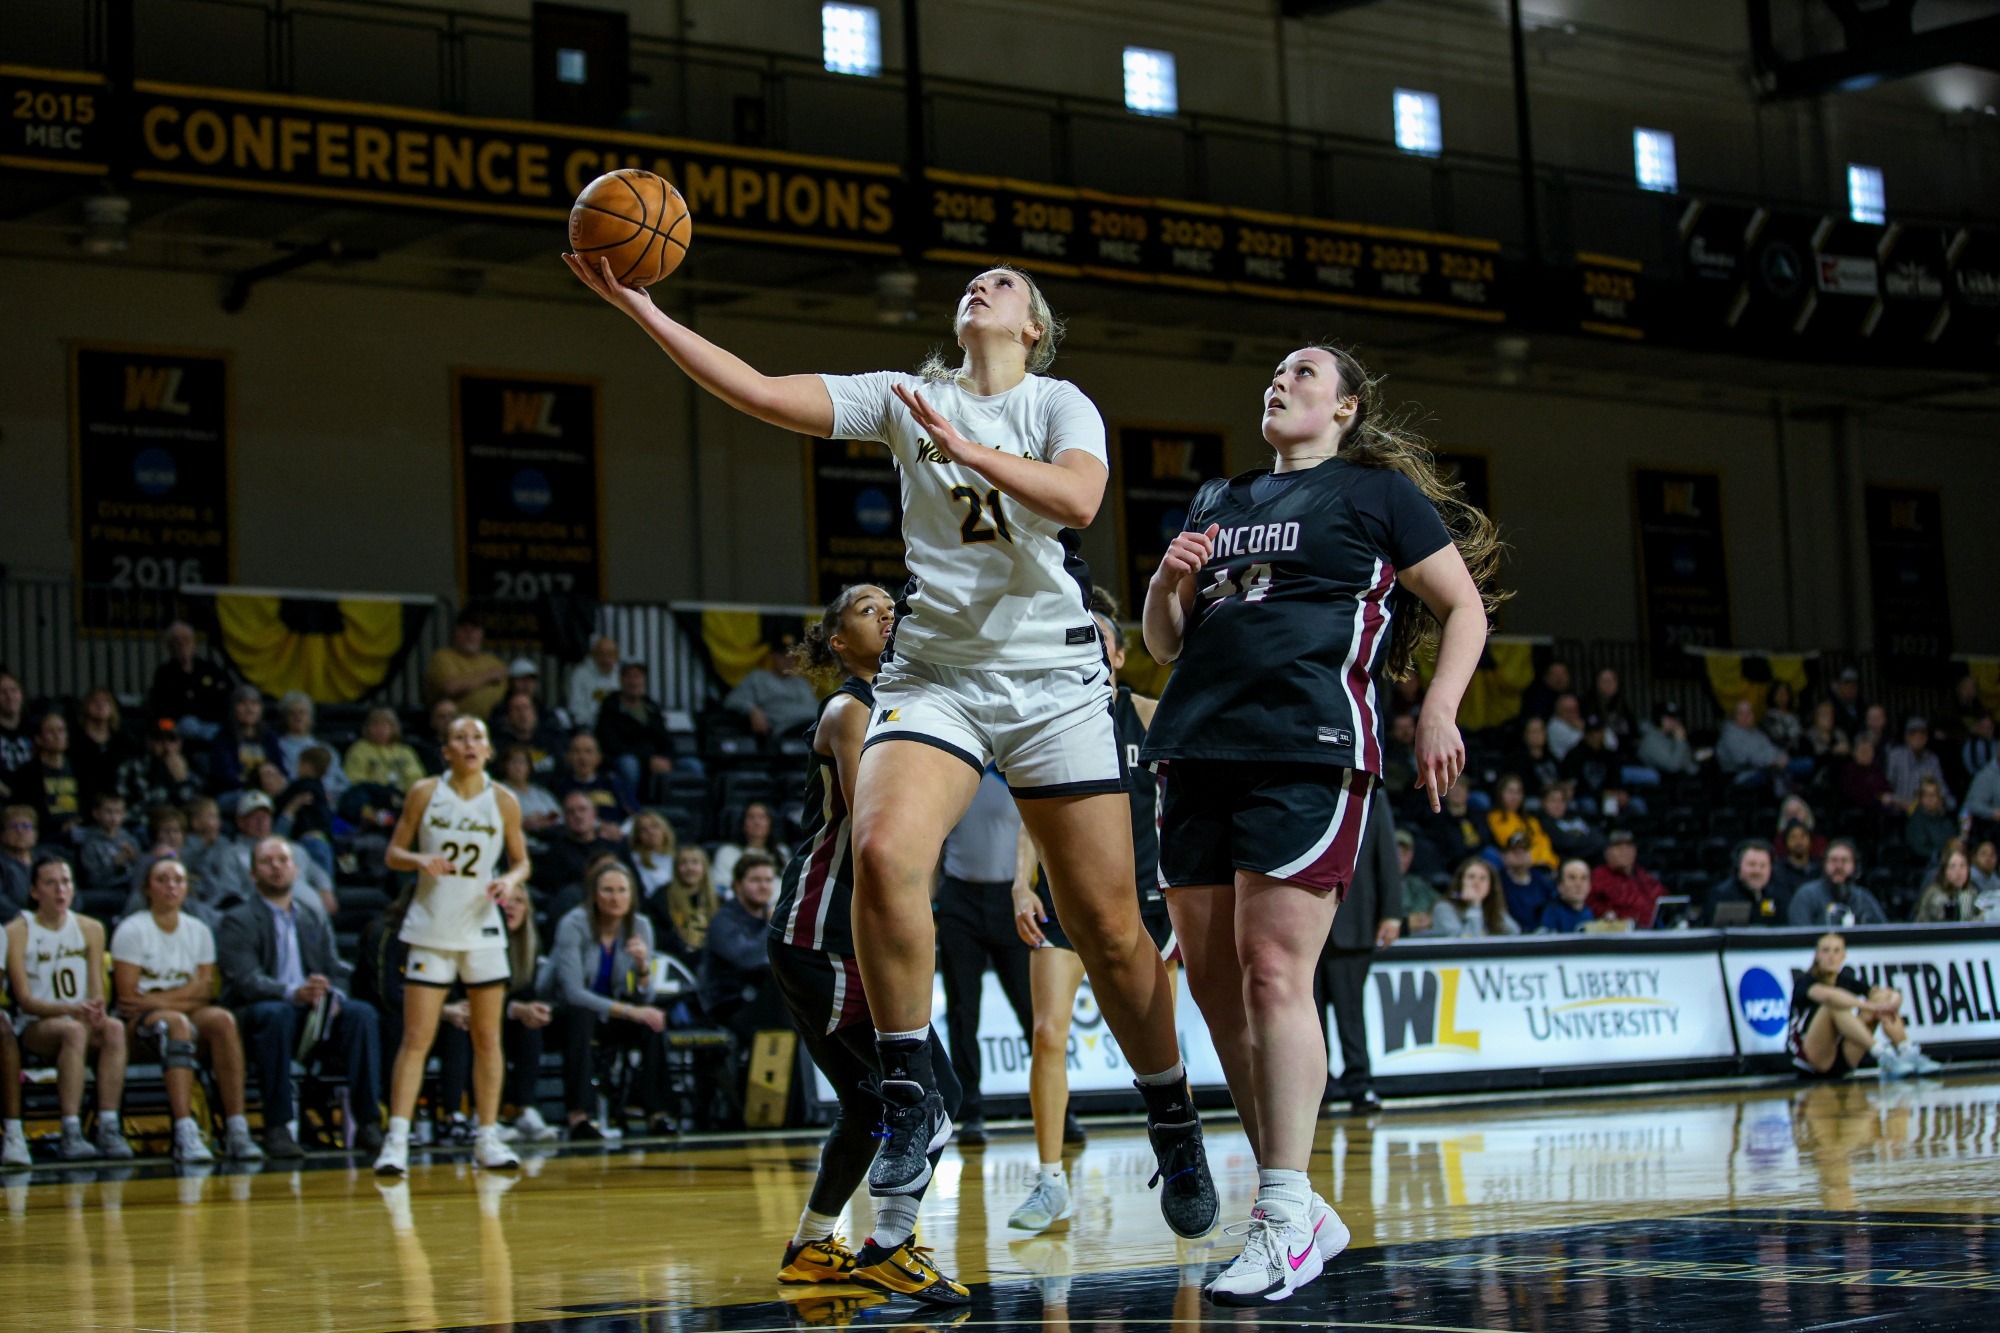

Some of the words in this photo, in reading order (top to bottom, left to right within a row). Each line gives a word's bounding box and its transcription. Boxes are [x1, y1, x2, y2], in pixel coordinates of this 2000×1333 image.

[11, 89, 96, 125] 2015
[24, 122, 84, 150] MEC
[142, 104, 553, 198] CONFERENCE
[932, 189, 996, 225] 2016
[1011, 200, 1074, 234] 2018
[123, 364, 191, 417] WL
[501, 389, 564, 439] WL
[951, 484, 1015, 544] 21
[1207, 521, 1301, 560] NCORD
[110, 554, 203, 590] 2016
[492, 569, 576, 602] 2017
[876, 709, 901, 727] WL
[442, 842, 480, 877] 22
[53, 969, 76, 1000] 10
[1791, 960, 2000, 1026] ETBALL
[1373, 968, 1480, 1054] WL
[1744, 997, 1788, 1023] NCAA
[983, 1036, 1082, 1073] TOPR
